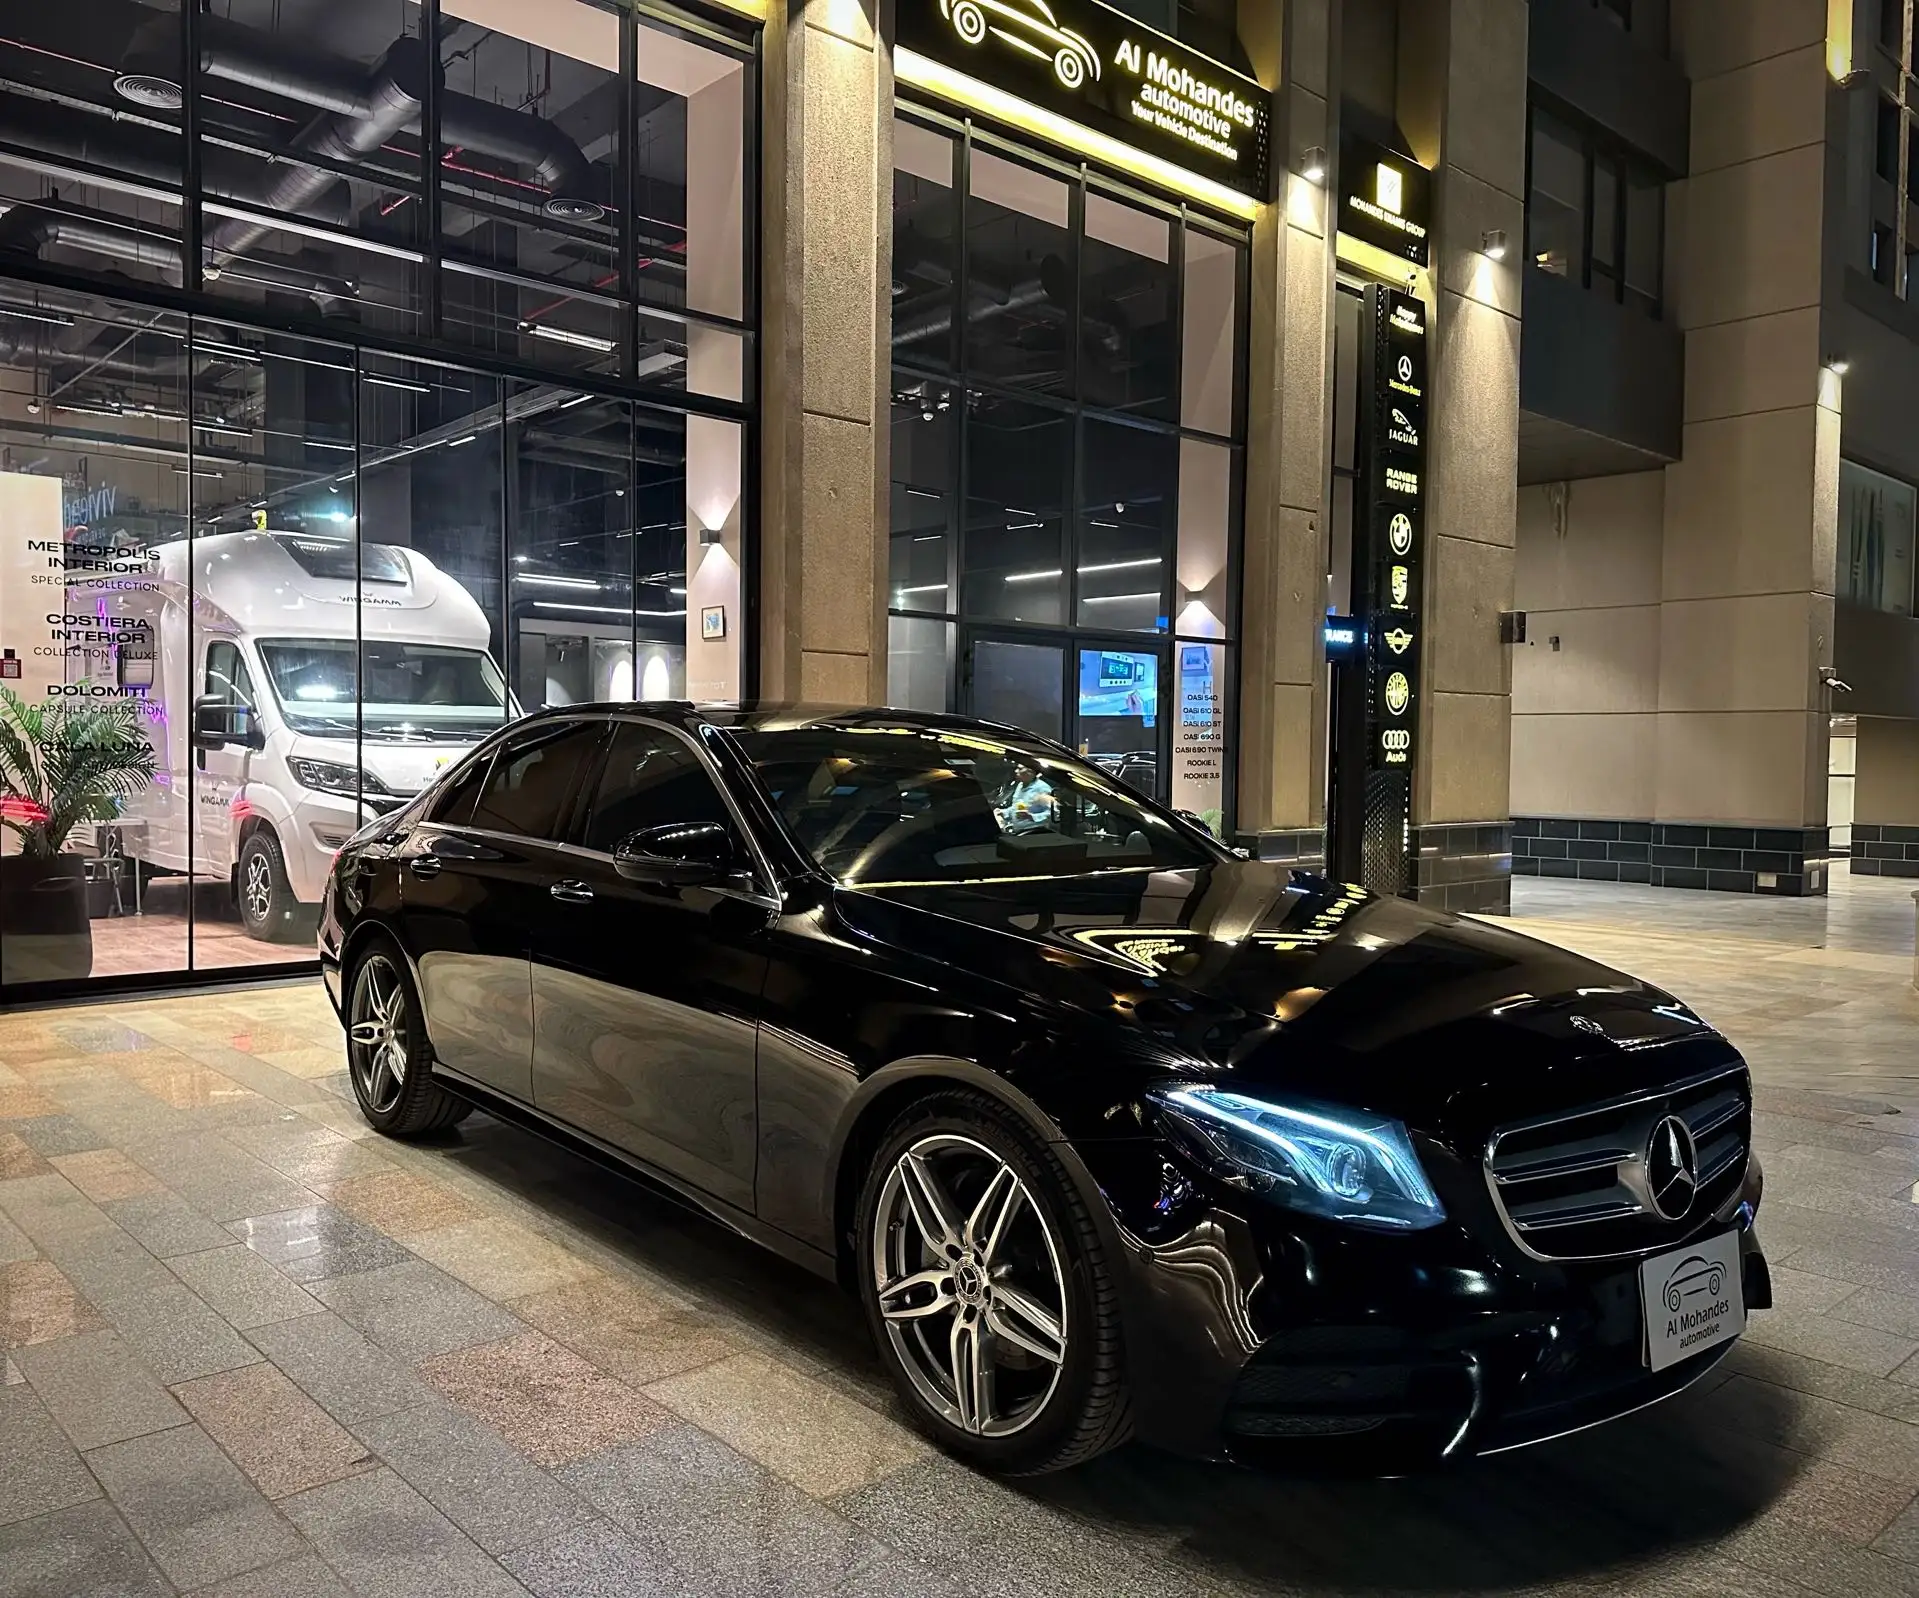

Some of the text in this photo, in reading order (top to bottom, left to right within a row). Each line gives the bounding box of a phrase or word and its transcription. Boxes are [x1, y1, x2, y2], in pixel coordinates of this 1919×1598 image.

[1114, 39, 1255, 128] Al Mohandes
[1140, 82, 1231, 138] automotive
[1131, 100, 1238, 161] Your Vehicle Destination
[1389, 429, 1418, 446] JAGUAR
[1386, 467, 1418, 484] RANGE
[1386, 478, 1418, 494] ROVER
[28, 540, 160, 560] METROPOLIS
[48, 557, 143, 574] INTERIOR
[31, 575, 160, 592] SPECIAL COLLECTION
[46, 613, 150, 629] COSTIERA
[51, 629, 146, 643] INTERIOR
[33, 646, 159, 660] COLLECTION DELUXE
[47, 685, 146, 698] DOLOMITI
[30, 704, 163, 715] CAPSULE COLLECTION
[101, 741, 155, 753] LUNA
[1385, 751, 1407, 762] Audi
[1666, 1299, 1729, 1338] Al Mohandes
[1679, 1321, 1720, 1349] automotive
